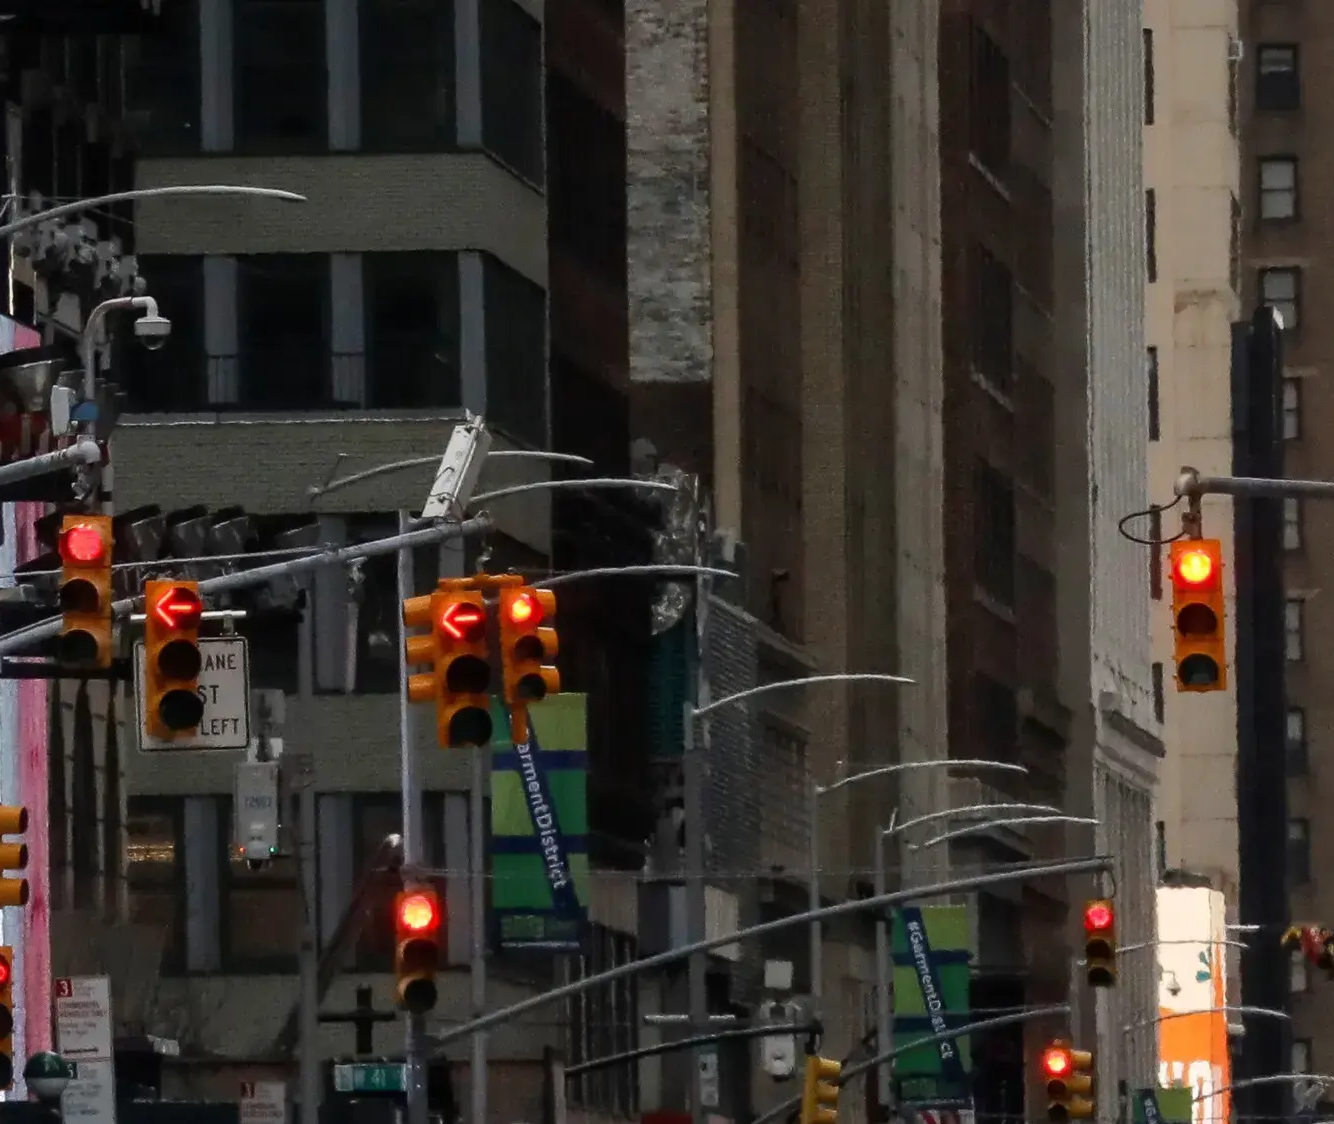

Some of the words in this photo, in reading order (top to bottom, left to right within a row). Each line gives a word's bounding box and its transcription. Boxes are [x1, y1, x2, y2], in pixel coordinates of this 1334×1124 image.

[202, 653, 237, 671] ANE
[197, 685, 220, 705] ST
[200, 718, 240, 736] LEFT
[516, 741, 567, 890] armentDistrict
[906, 920, 957, 1060] #GarmentDistct
